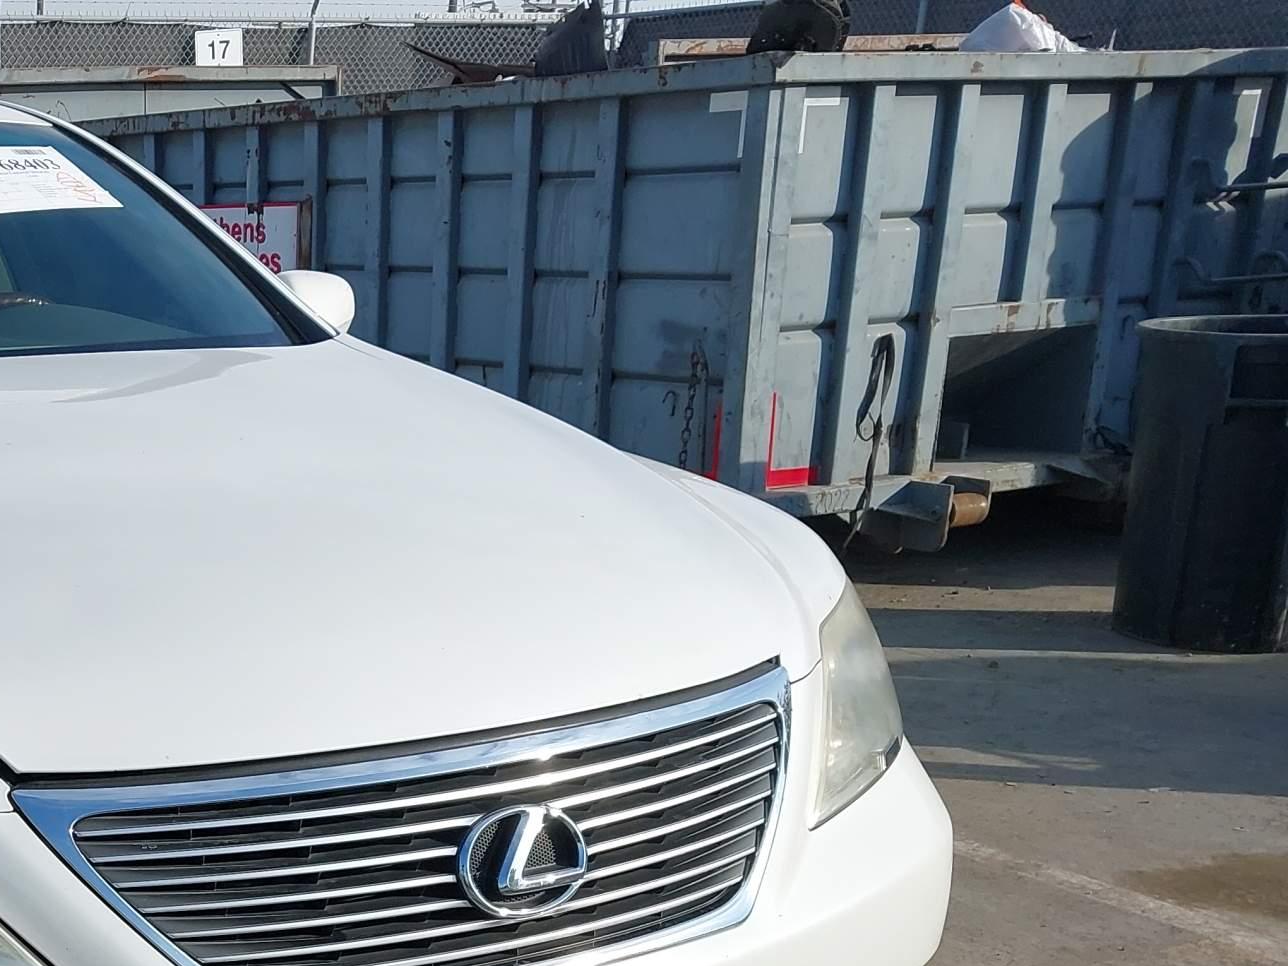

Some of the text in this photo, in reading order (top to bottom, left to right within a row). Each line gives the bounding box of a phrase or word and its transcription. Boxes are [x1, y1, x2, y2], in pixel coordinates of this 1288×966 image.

[207, 39, 231, 60] 17
[213, 216, 267, 244] hens
[258, 252, 282, 275] es
